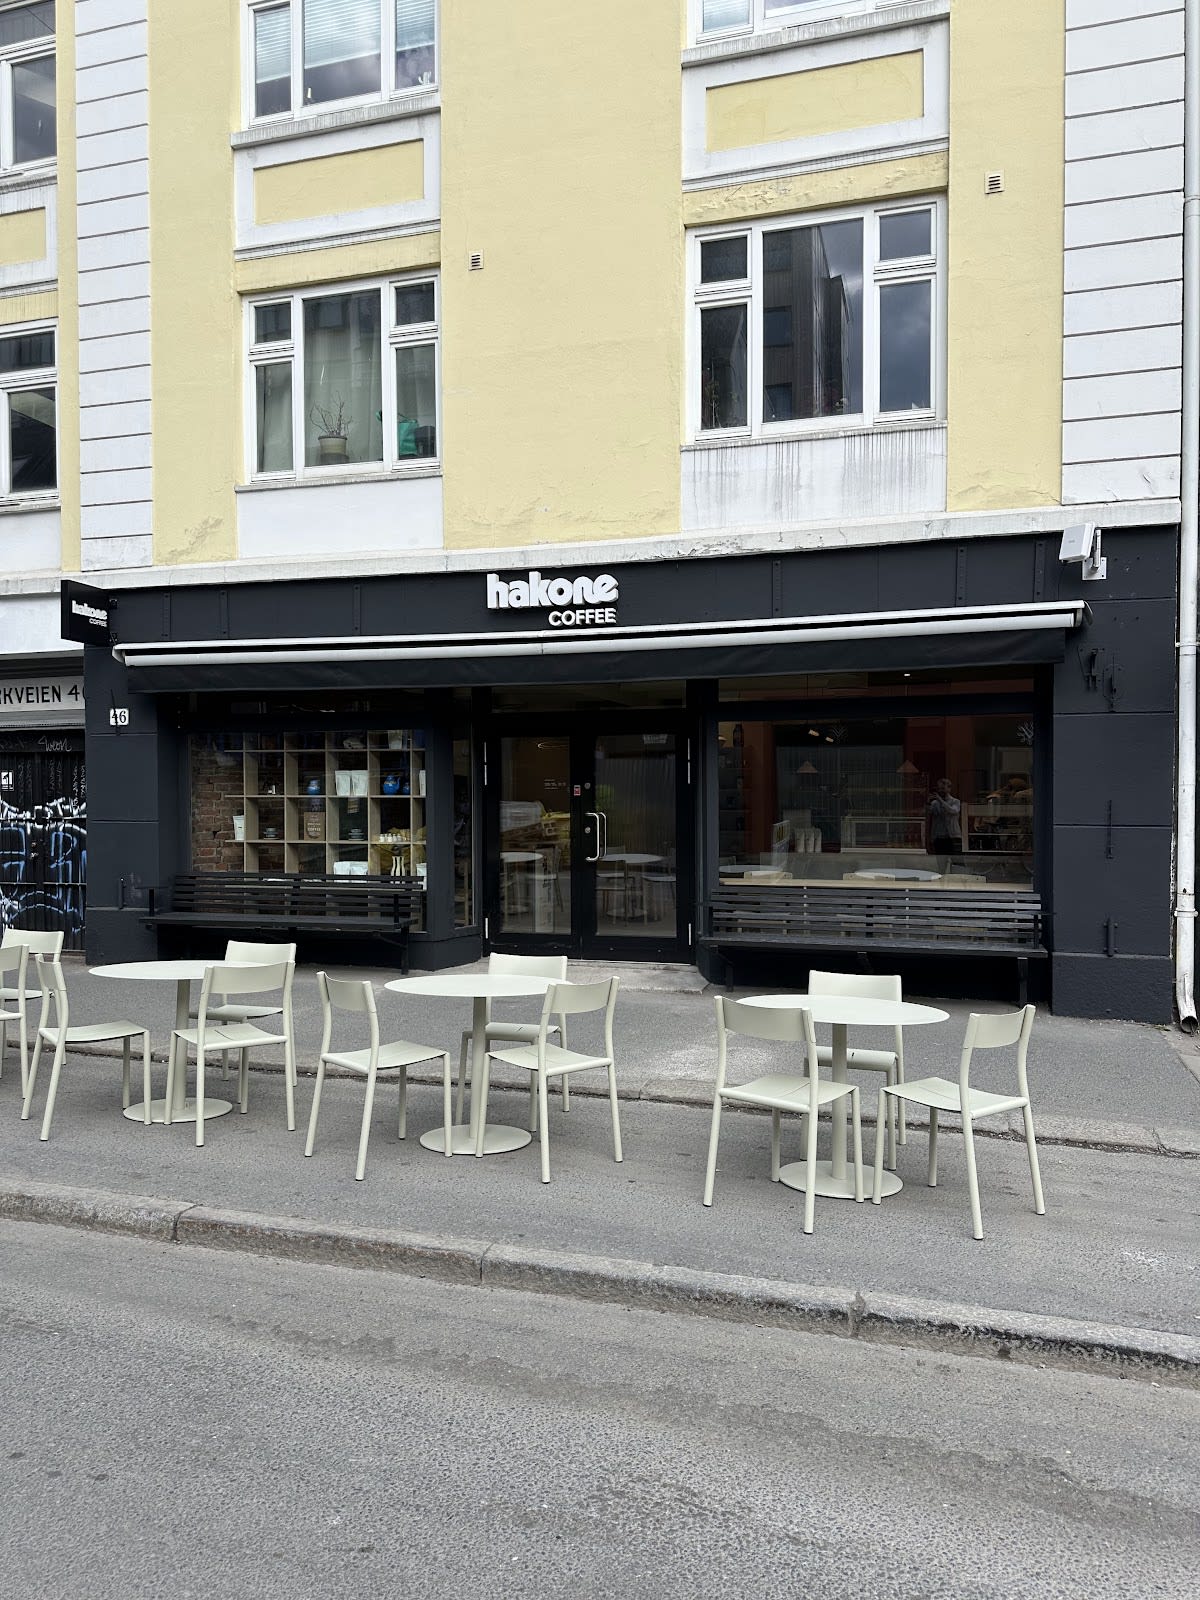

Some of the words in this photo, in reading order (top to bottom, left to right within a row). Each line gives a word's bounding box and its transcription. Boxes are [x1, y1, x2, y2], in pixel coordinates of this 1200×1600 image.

[487, 571, 618, 609] hakone
[71, 600, 108, 619] hakone
[548, 608, 617, 626] COFFEE
[0, 685, 61, 704] KVEIEN
[112, 710, 127, 723] 46
